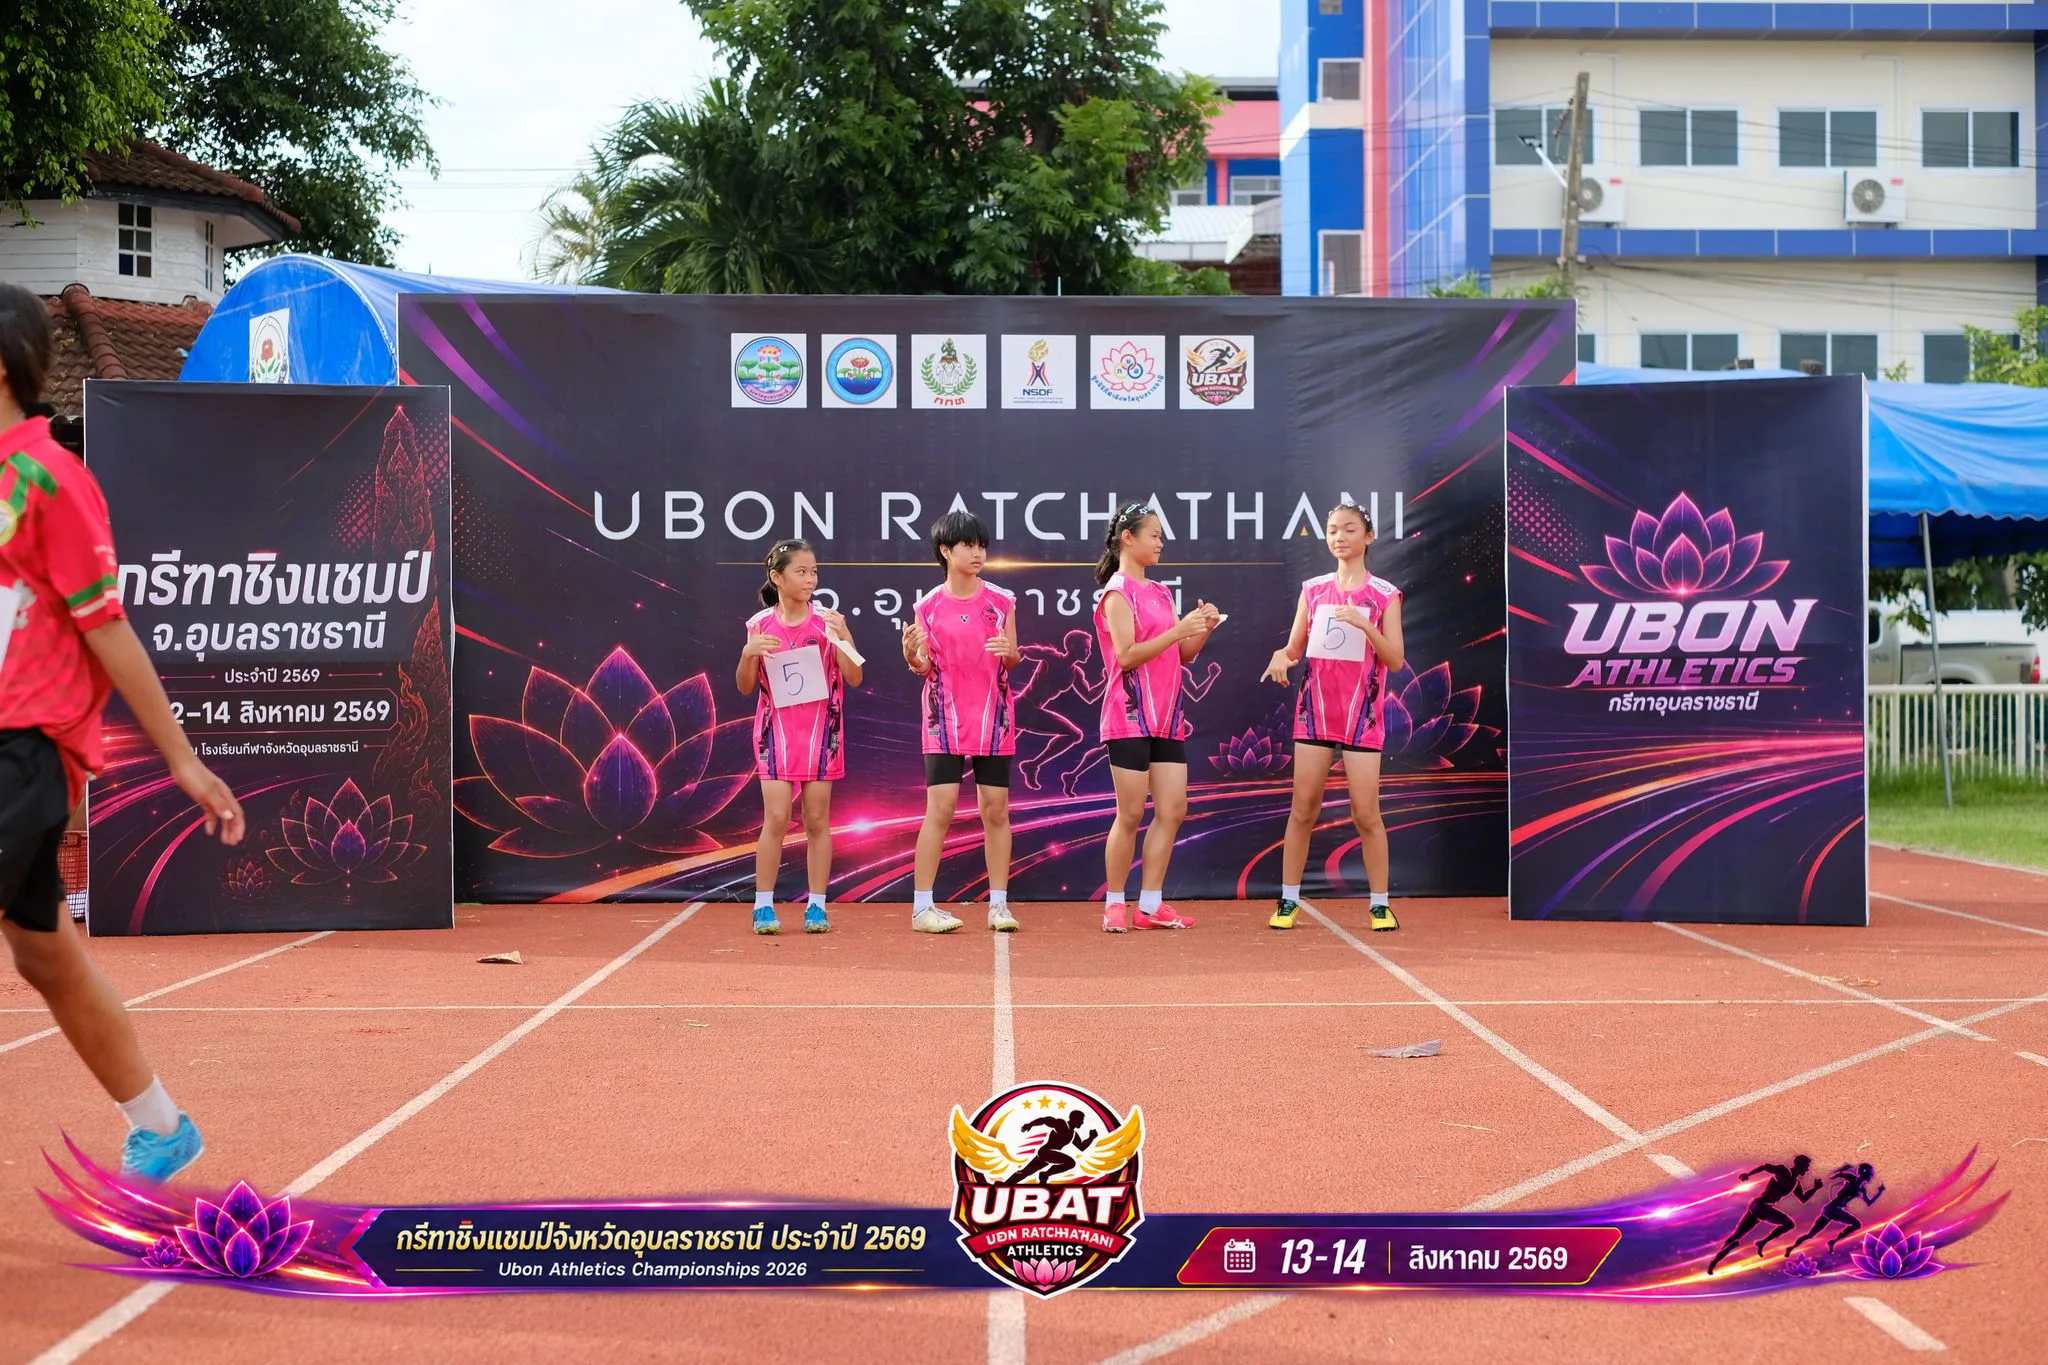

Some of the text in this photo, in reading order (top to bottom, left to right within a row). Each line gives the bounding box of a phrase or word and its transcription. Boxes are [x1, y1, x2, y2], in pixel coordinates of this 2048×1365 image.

[1022, 388, 1054, 396] NSDF
[1191, 373, 1243, 386] UBAT
[934, 396, 965, 406] กกท
[594, 490, 834, 541] UBON
[118, 550, 432, 606] กรีฑาชิงแชมป์
[152, 611, 387, 662] จ.อุบลราชธานี
[1323, 616, 1346, 650] 5
[1564, 599, 1819, 655] UBON
[224, 667, 320, 683] ประจำปี 2569
[782, 661, 804, 696] 5
[1566, 656, 1807, 688] ATHLETICS
[240, 700, 325, 724] สิงหาคม
[333, 701, 391, 722] 2569
[1608, 691, 1759, 717] กรีฑาอุบลราชธานี
[201, 740, 359, 759] โรงเรียนกีฬาจังหวัดอุบลราชธานี
